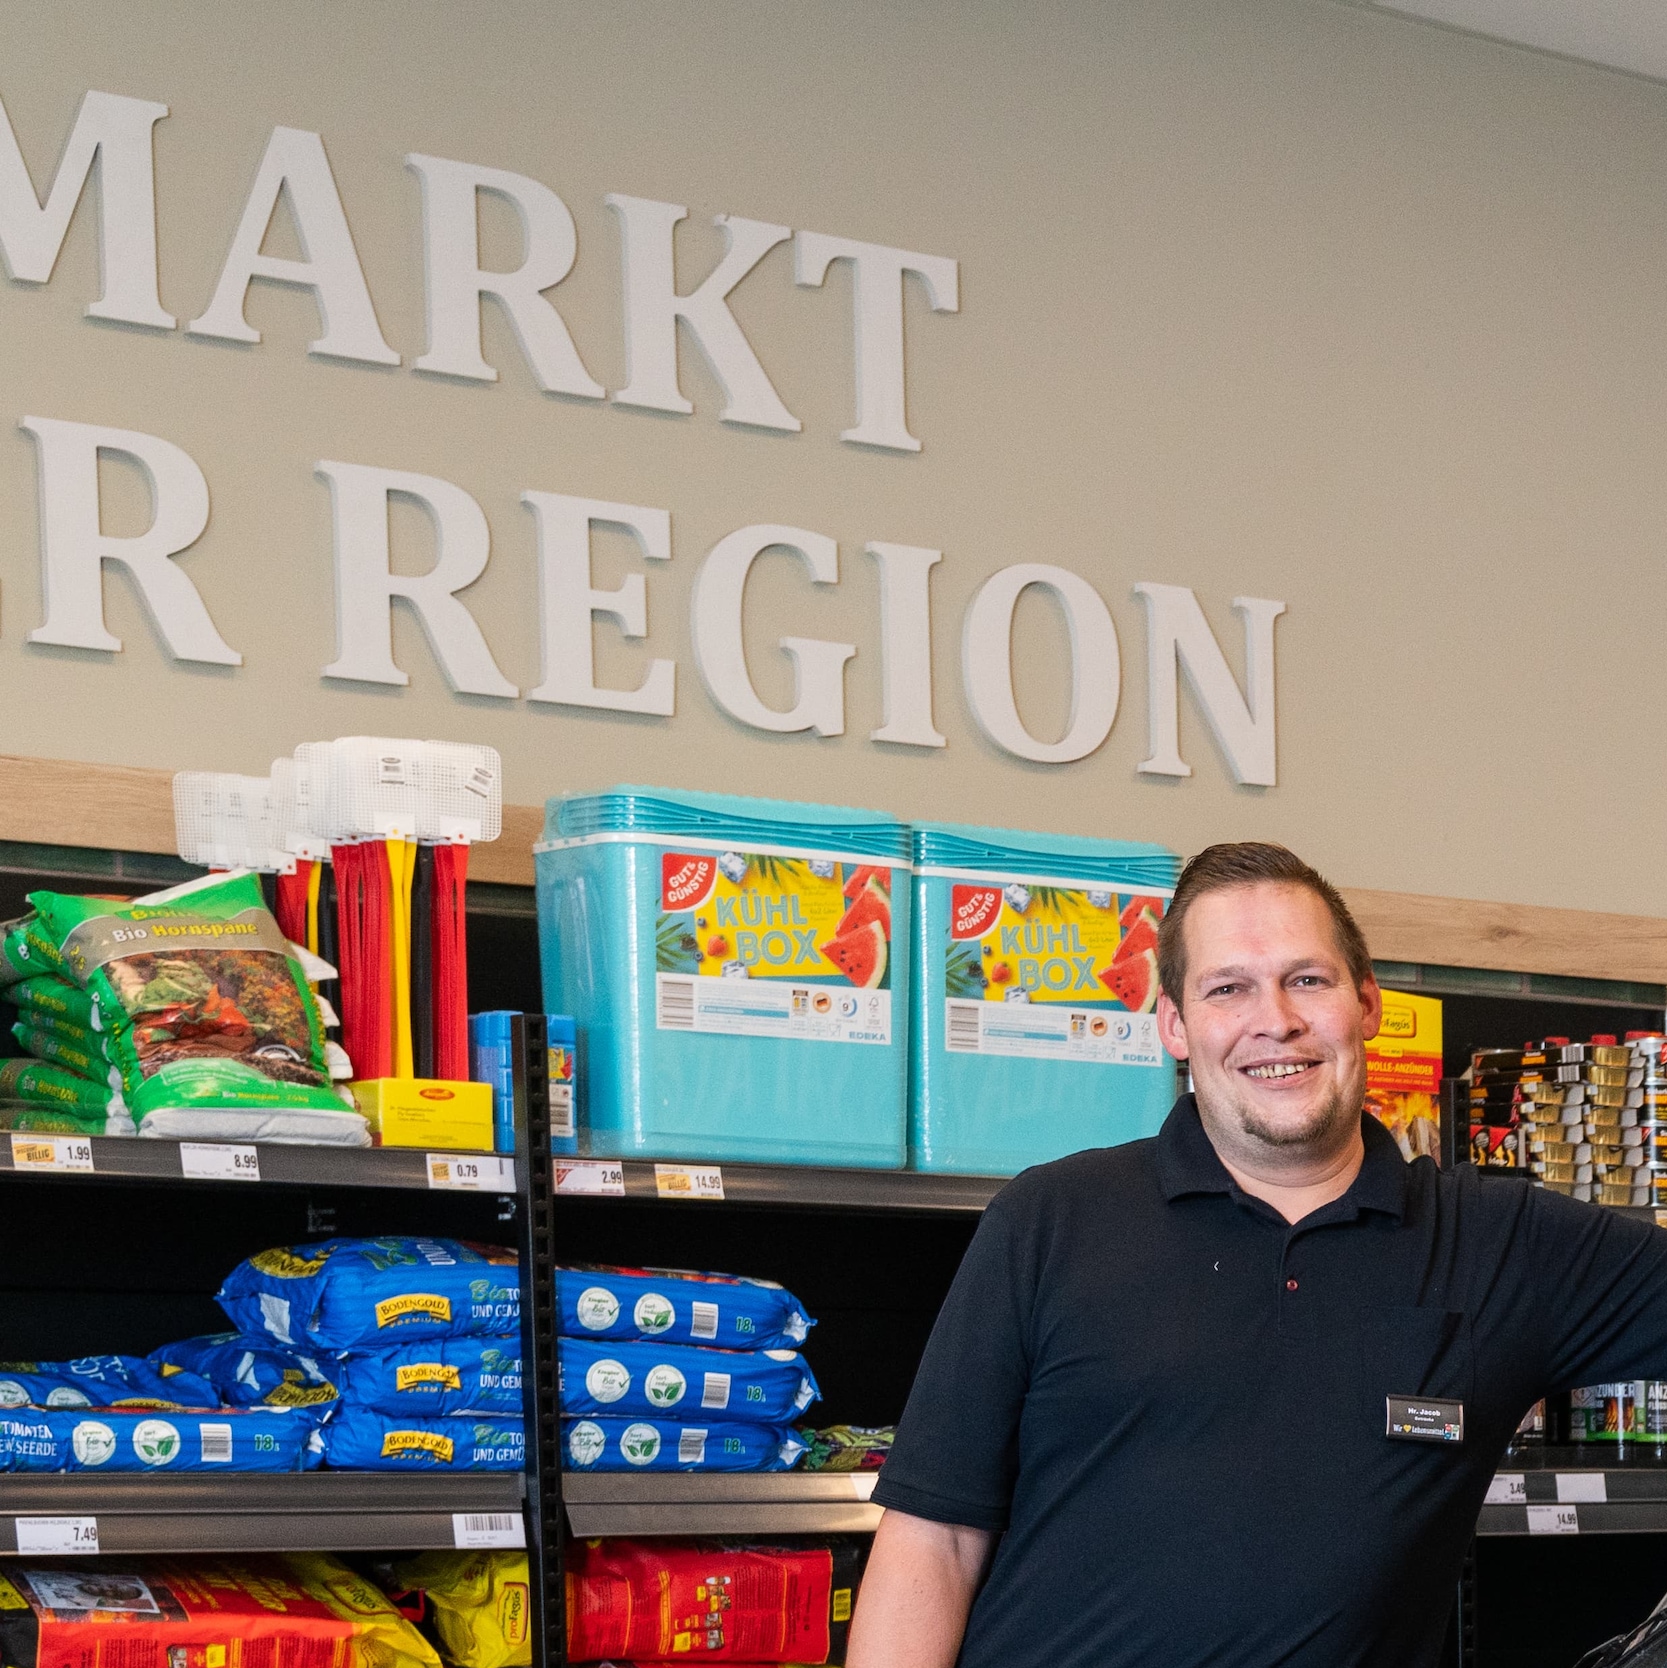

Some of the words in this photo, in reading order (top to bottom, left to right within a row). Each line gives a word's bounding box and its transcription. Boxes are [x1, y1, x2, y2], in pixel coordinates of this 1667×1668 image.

[316, 458, 1287, 787] REGION
[668, 860, 709, 903] GÜNSTIG
[715, 888, 808, 928] KÜHL
[956, 892, 996, 932] GÜNSTIG
[112, 924, 148, 943] Bio
[1000, 918, 1087, 955] KÜHL
[735, 928, 823, 967] BOX
[1018, 956, 1100, 992] BOX
[848, 1031, 887, 1041] EDEKA
[1122, 1053, 1158, 1063] EDEKA
[67, 1138, 92, 1162] 1.99
[234, 1153, 258, 1171] 8.99
[457, 1162, 479, 1179] 0.79
[601, 1170, 623, 1184] 2.99
[695, 1174, 721, 1189] 14.99
[380, 1298, 445, 1317] BODENGOLD
[472, 1305, 493, 1318] UND
[480, 1375, 499, 1388] UND
[1420, 1408, 1441, 1417] Jacob
[389, 1433, 449, 1451] BODENGOLD
[473, 1448, 494, 1462] UND
[1557, 1512, 1577, 1525] 14.99
[73, 1526, 97, 1542] 7.49
